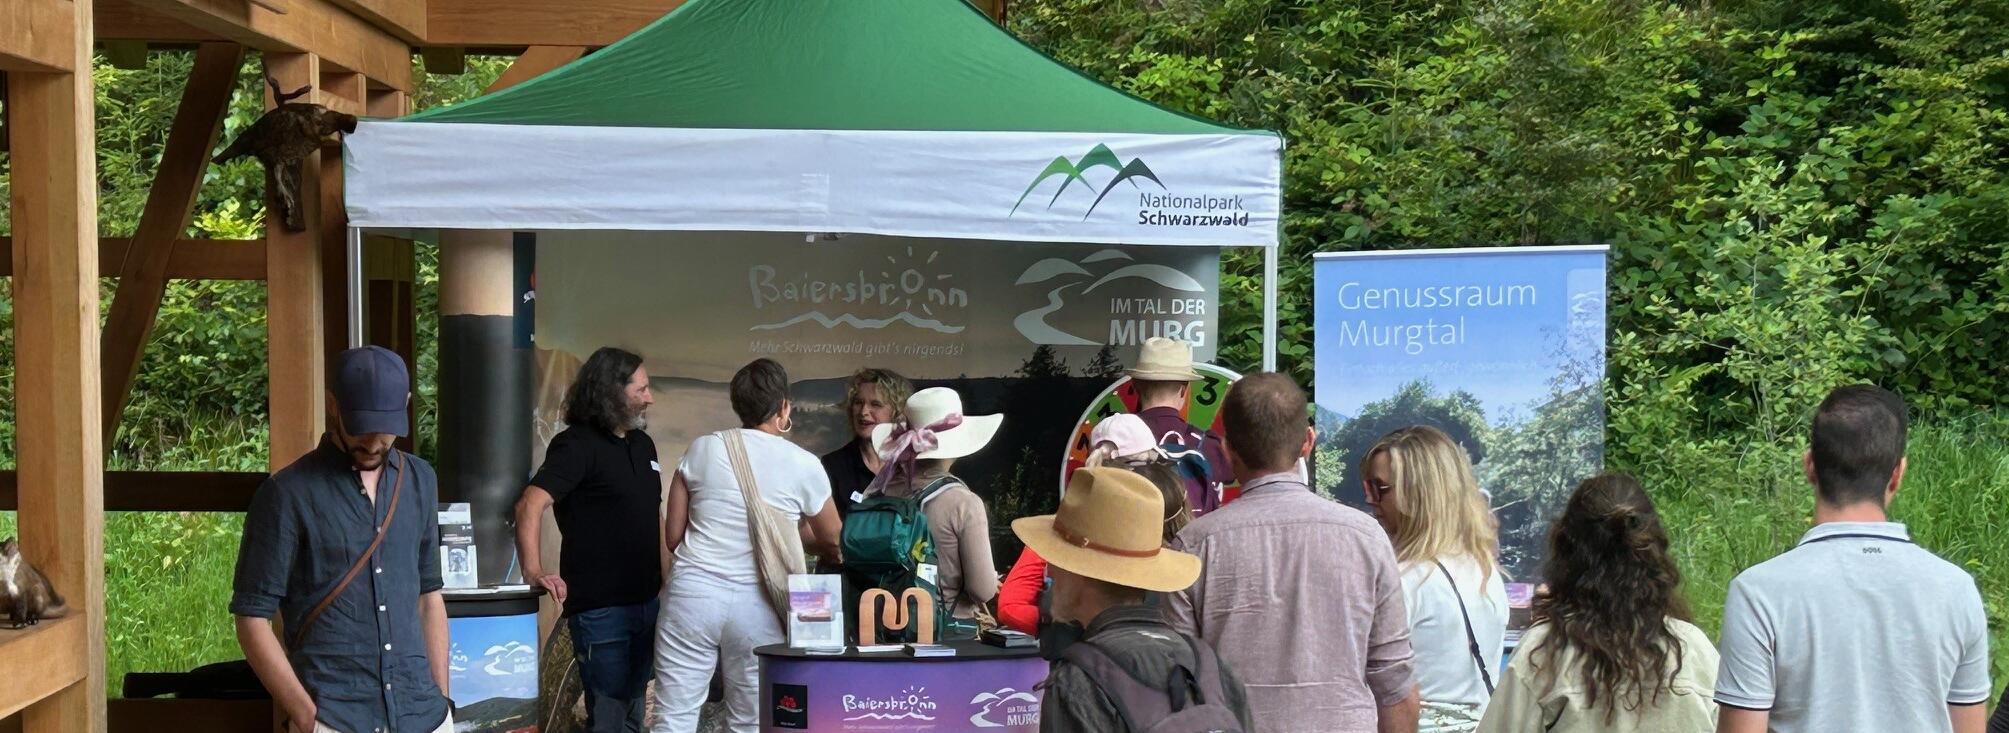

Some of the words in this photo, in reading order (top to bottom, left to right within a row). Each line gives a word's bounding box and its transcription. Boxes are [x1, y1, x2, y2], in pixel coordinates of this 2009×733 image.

[1140, 193, 1243, 210] Nationalpark
[1139, 210, 1249, 227] Schwarzwald
[1338, 282, 1536, 310] Genussraum
[1111, 298, 1132, 314] IM
[1134, 298, 1167, 314] TAL
[1171, 298, 1205, 315] DER
[1109, 319, 1205, 347] MURG
[1339, 316, 1465, 355] Murgtal
[750, 341, 780, 353] Mehr
[782, 340, 864, 354] Schwarzwald
[1196, 376, 1220, 406] 3
[1007, 713, 1039, 726] MURG
